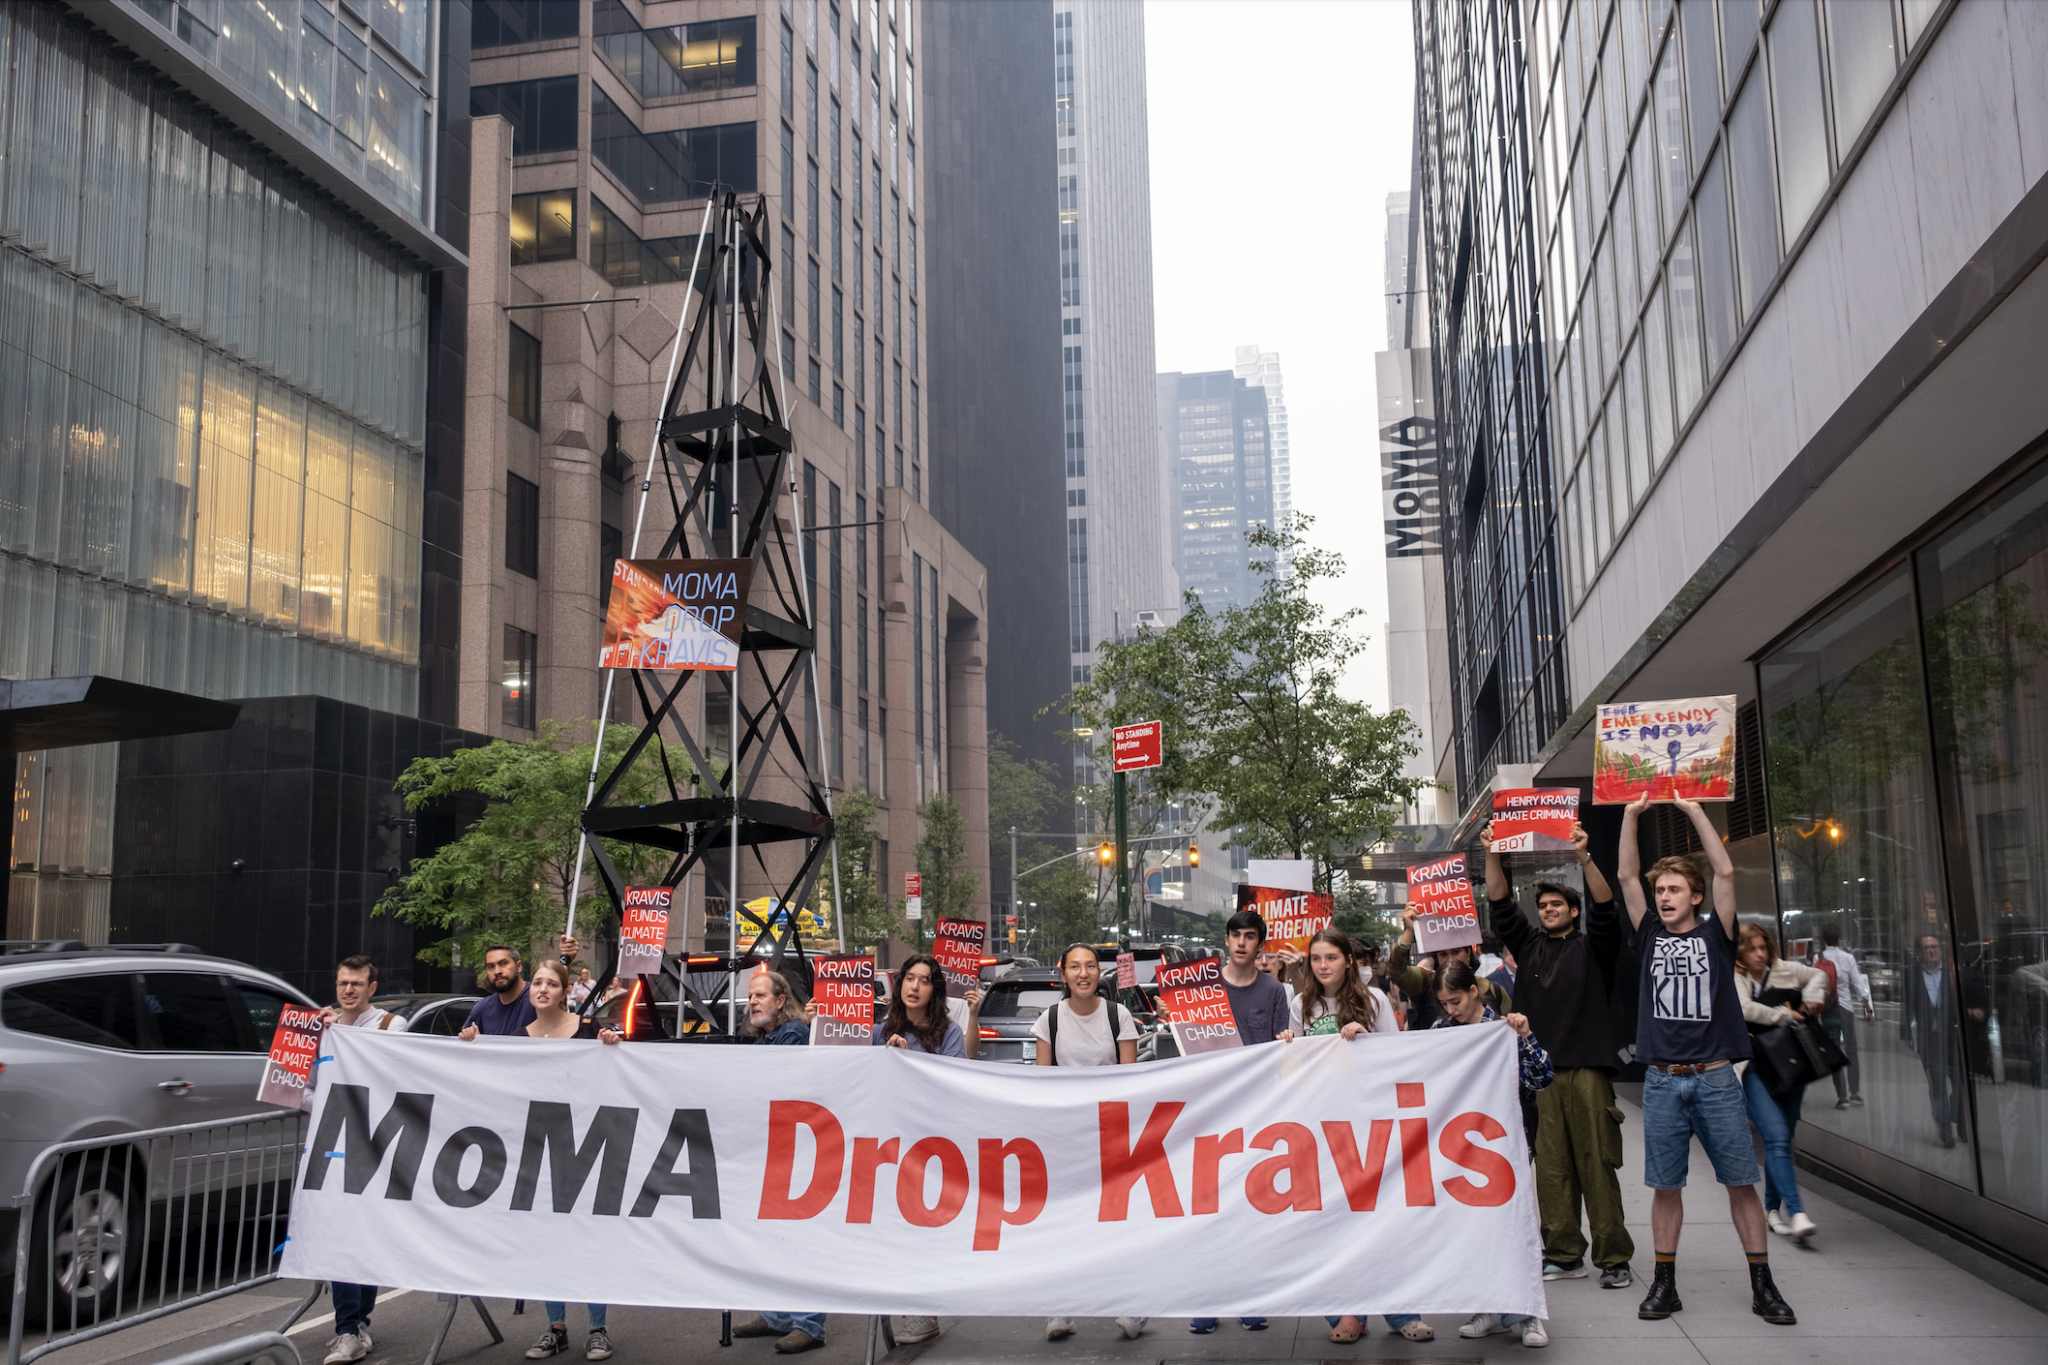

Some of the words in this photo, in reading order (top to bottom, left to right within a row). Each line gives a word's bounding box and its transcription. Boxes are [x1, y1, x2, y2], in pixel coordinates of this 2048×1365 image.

[1380, 416, 1422, 558] MoMA
[662, 572, 738, 600] MOMA
[664, 606, 736, 632] DROP
[640, 638, 729, 666] KRAVIS
[1602, 708, 1719, 728] EMERGENCY
[1116, 732, 1124, 740] NO
[1125, 726, 1154, 739] STANDING
[1600, 729, 1632, 742] IS
[1640, 720, 1718, 741] NOW
[1116, 740, 1140, 751] Anytime
[1506, 796, 1540, 807] HENRY
[1540, 795, 1579, 806] KRAVIS
[1493, 810, 1528, 822] CLIMATE
[1530, 809, 1577, 820] CRIMINAL
[1498, 835, 1527, 852] BOY
[1410, 858, 1464, 884] KRAVIS
[1421, 877, 1468, 898] FUNDS
[626, 890, 670, 906] KRAVIS
[1414, 894, 1472, 917] CLIMATE
[630, 909, 668, 923] FUNDS
[1426, 913, 1476, 933] CHAOS
[623, 926, 665, 940] CLIMATE
[940, 922, 984, 939] KRAVIS
[625, 943, 662, 957] CHAOS
[945, 940, 981, 955] FUNDS
[1654, 939, 1706, 956] FOSSIL
[818, 961, 872, 978] KRAVIS
[1160, 962, 1219, 988] KRAVIS
[1652, 956, 1708, 976] FUELS
[826, 983, 872, 998] FUNDS
[1174, 984, 1224, 1005] FUNDS
[1652, 976, 1709, 1019] KILL
[281, 1009, 322, 1031] KRAVIS
[817, 1003, 871, 1018] CLIMATE
[1170, 1003, 1230, 1024] CLIMATE
[823, 1023, 871, 1038] CHAOS
[1185, 1022, 1236, 1041] CHAOS
[282, 1031, 317, 1050] FUNDS
[271, 1049, 312, 1069] CLIMATE
[271, 1069, 307, 1088] CHAOS
[302, 1082, 722, 1219] MoMA
[758, 1100, 1048, 1251] Drop
[1098, 1082, 1516, 1222] Kravis
